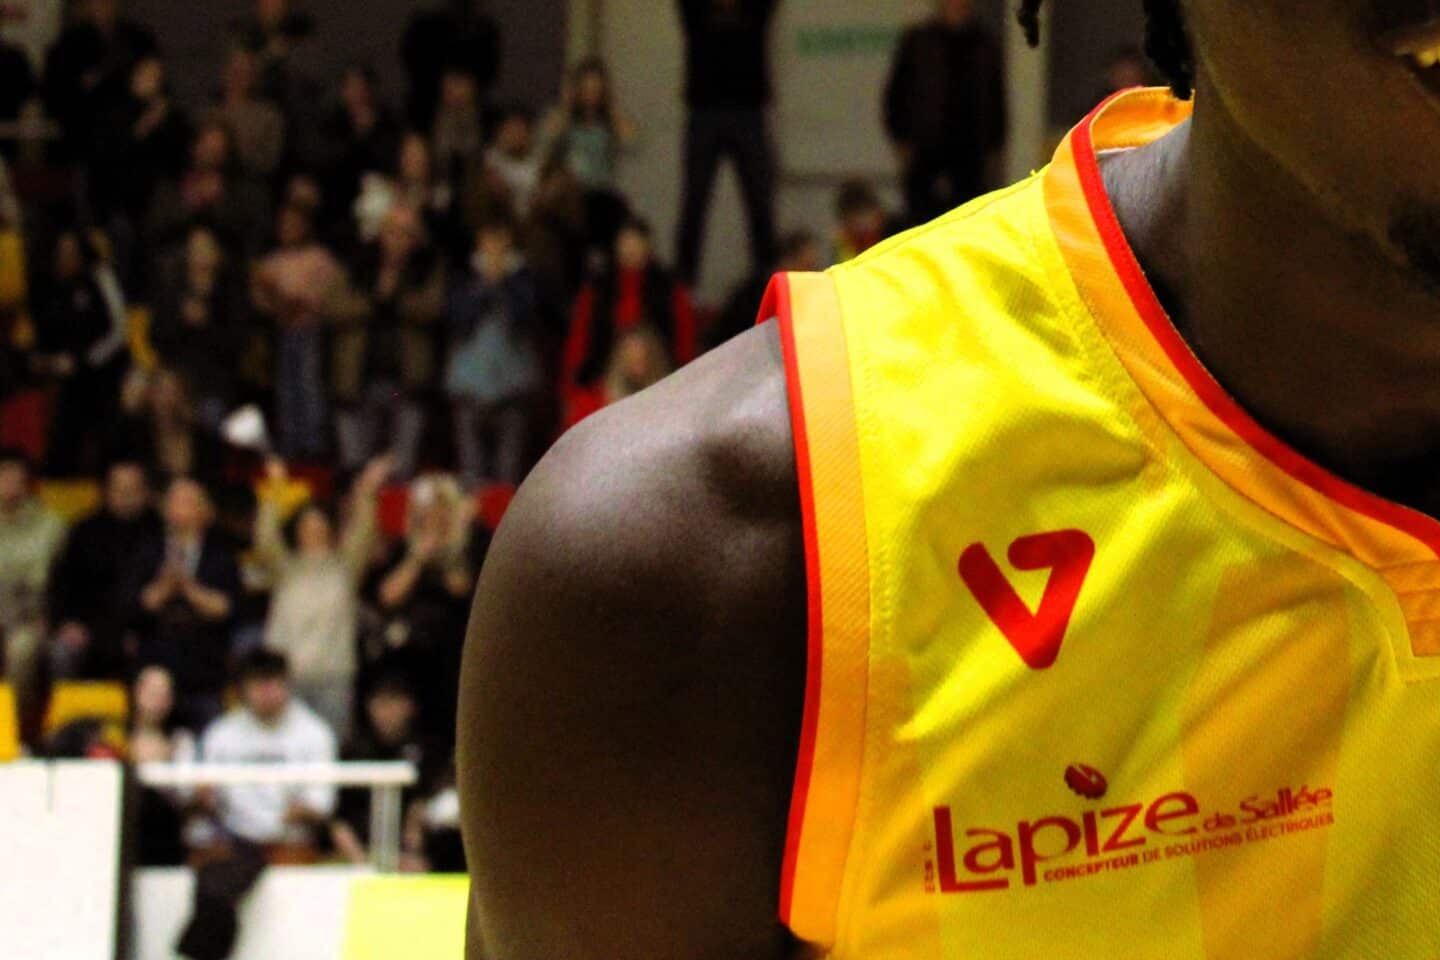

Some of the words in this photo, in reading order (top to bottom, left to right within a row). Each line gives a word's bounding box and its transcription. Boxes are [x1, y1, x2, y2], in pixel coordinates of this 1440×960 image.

[934, 788, 1199, 895] Lapize
[1202, 811, 1237, 833] de
[1239, 783, 1334, 823] Sallée
[1043, 854, 1139, 883] CONCEPTEUR
[1142, 846, 1162, 864] DE
[1165, 833, 1243, 857] SOLUTIONS
